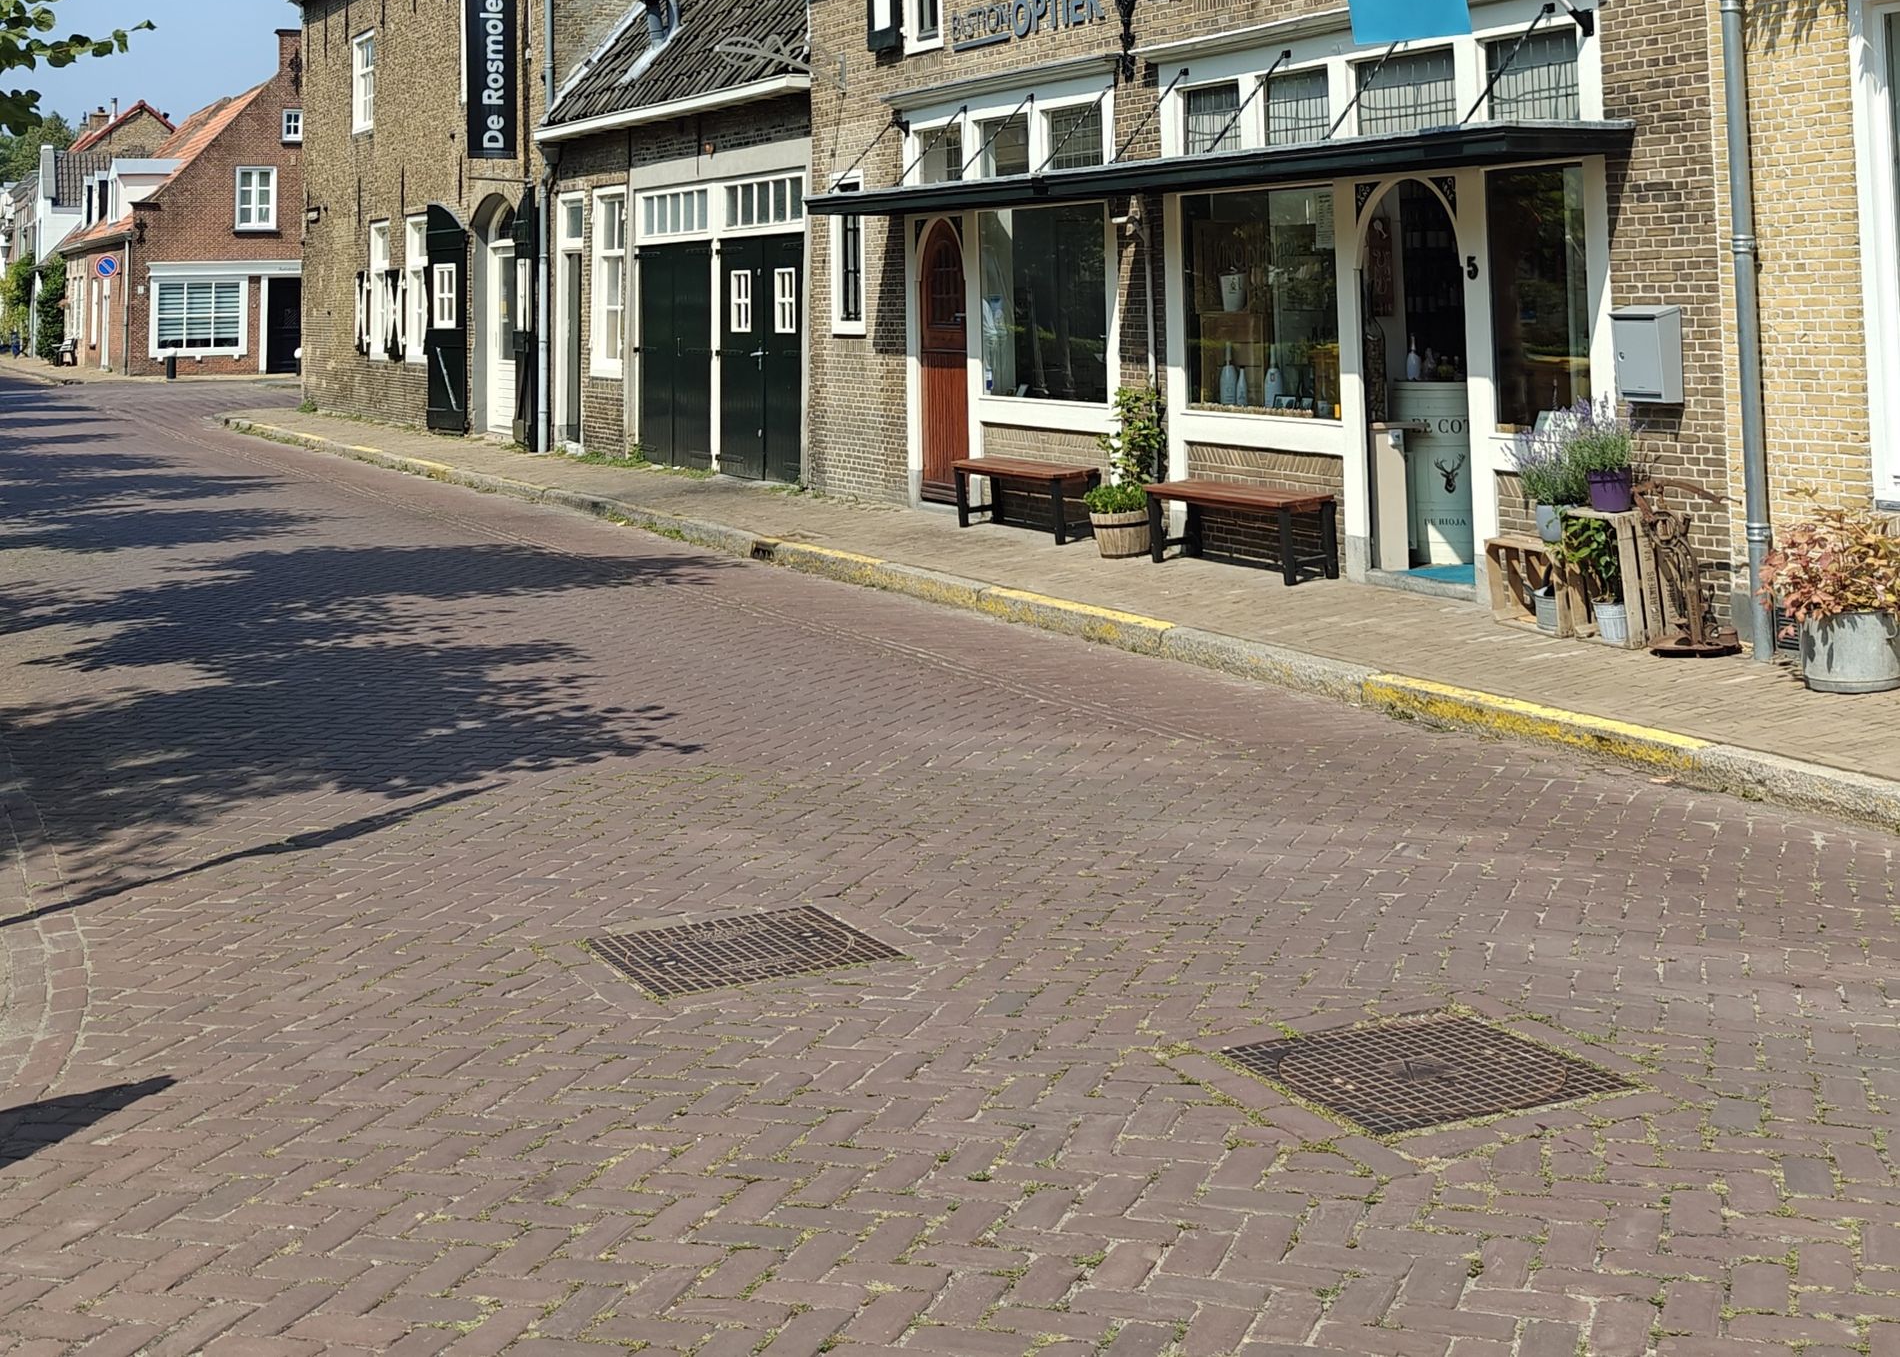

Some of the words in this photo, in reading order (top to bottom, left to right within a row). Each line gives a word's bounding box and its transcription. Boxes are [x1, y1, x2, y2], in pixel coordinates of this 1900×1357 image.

[482, 114, 505, 149] De
[1467, 255, 1479, 281] 5
[1439, 518, 1467, 526] RIOJA
